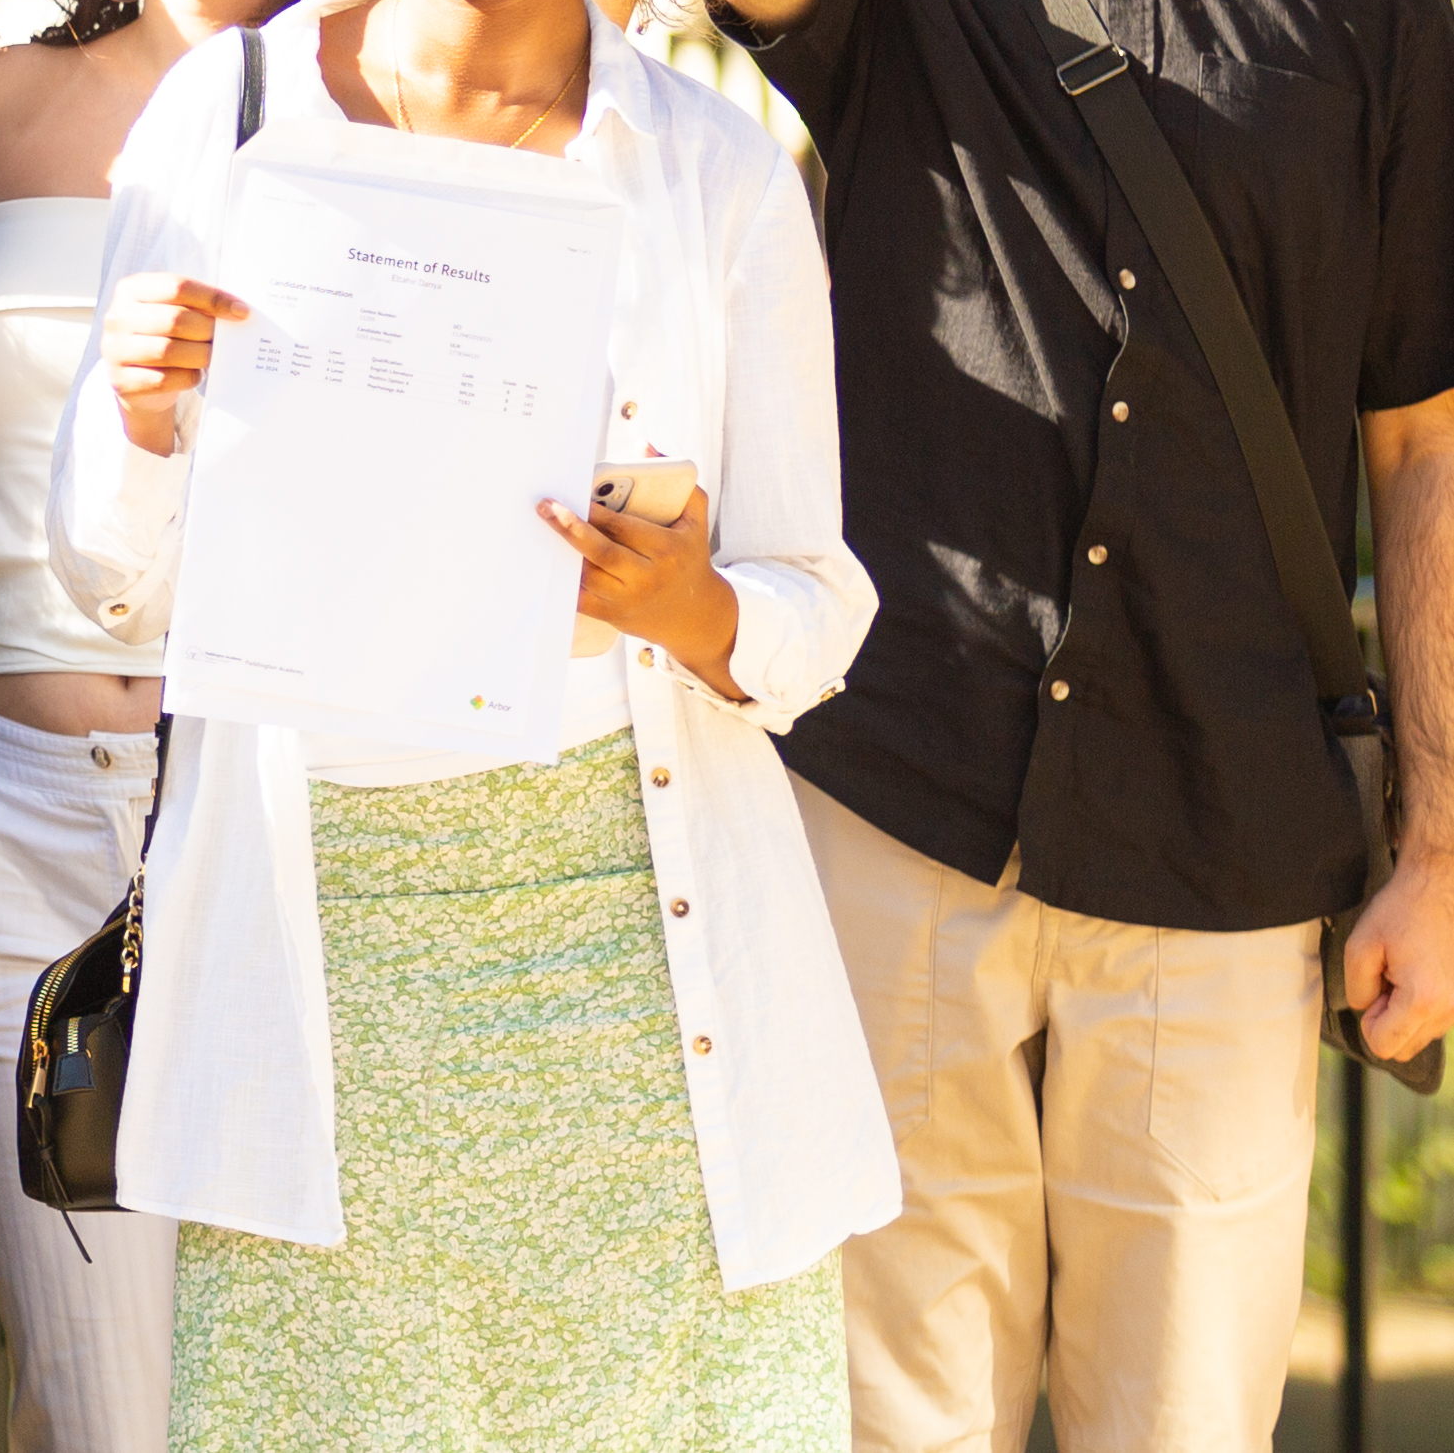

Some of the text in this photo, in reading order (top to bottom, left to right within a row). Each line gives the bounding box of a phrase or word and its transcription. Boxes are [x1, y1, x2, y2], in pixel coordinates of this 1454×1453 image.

[347, 248, 491, 284] Statement of Results
[269, 279, 353, 299] Candidate Information
[487, 700, 512, 712] Arbor
